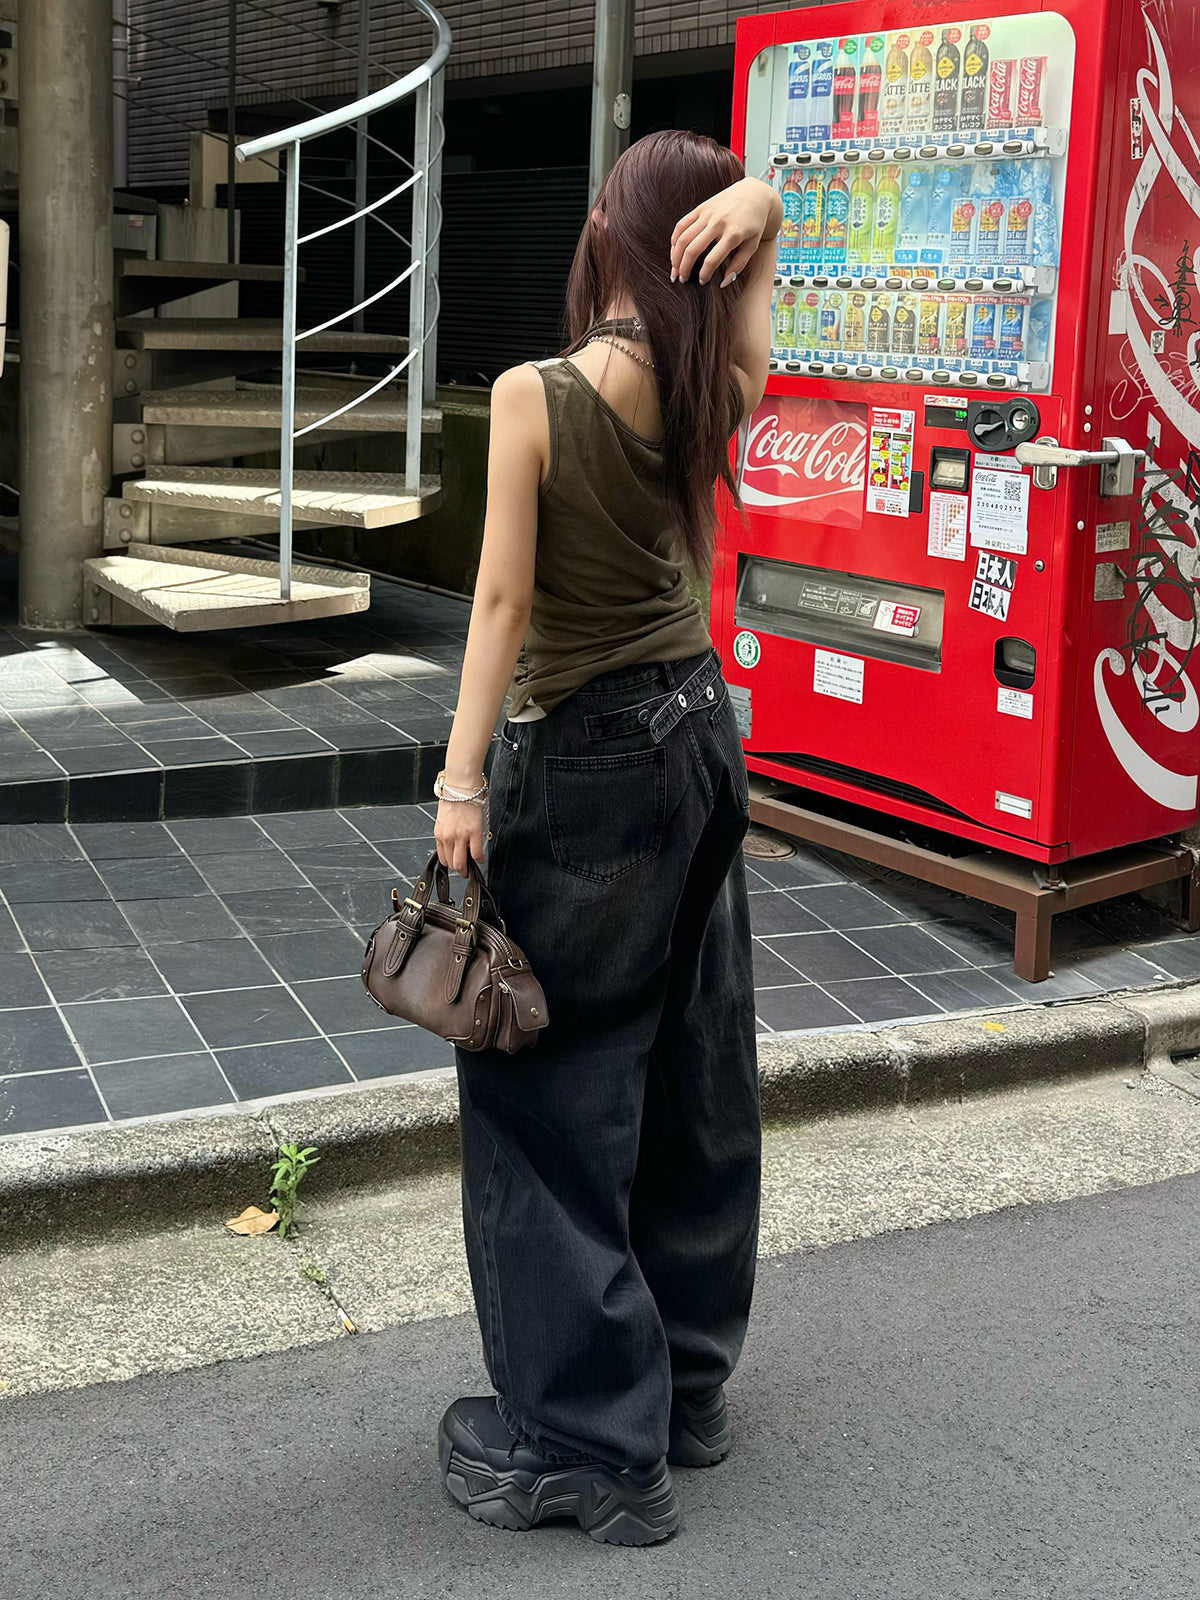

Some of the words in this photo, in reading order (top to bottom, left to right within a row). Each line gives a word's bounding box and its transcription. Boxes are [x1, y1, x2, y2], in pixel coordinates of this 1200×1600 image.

[975, 552, 1013, 589] 日本人
[971, 582, 1005, 619] 日本人
